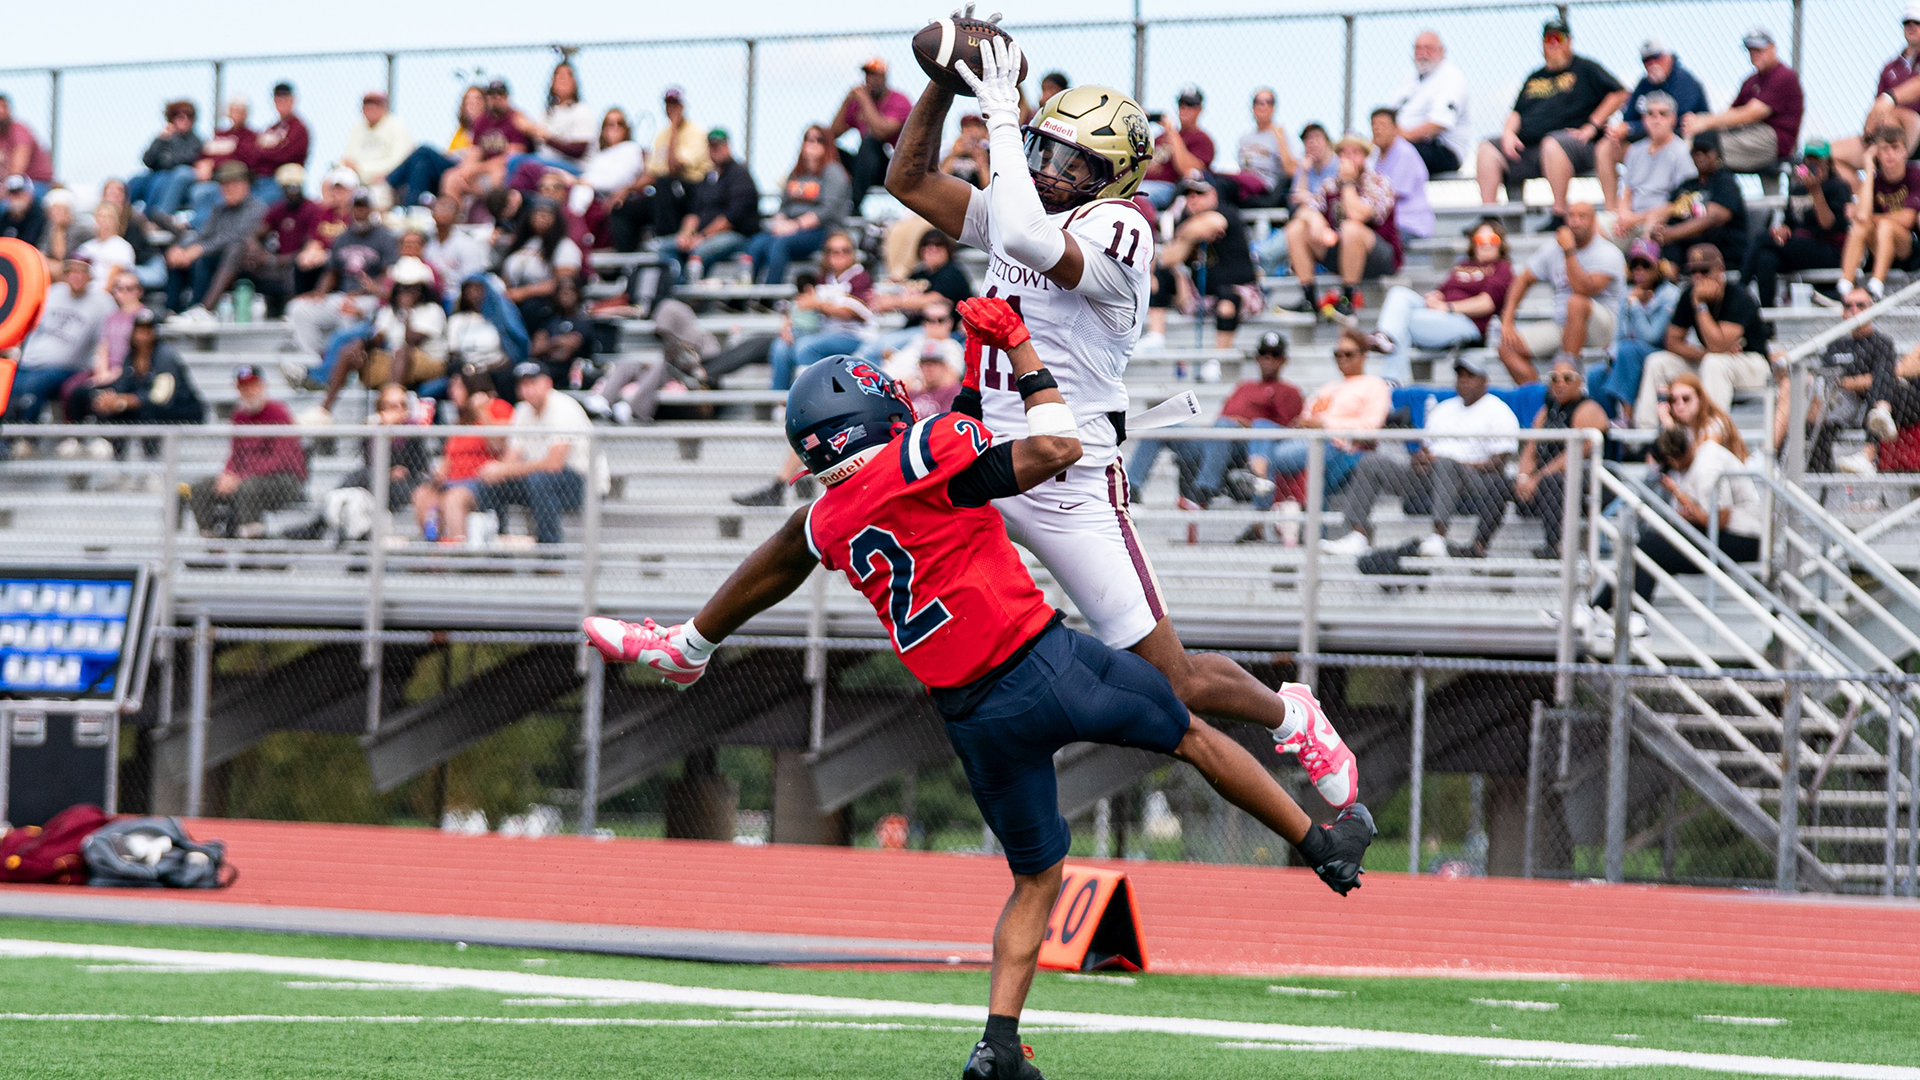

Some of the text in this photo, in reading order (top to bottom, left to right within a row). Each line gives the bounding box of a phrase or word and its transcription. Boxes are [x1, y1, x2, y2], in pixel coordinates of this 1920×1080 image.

[1043, 120, 1074, 137] Riddell
[1103, 220, 1140, 268] 11
[953, 419, 989, 456] 2
[819, 456, 865, 484] Riddell
[848, 524, 954, 654] 2
